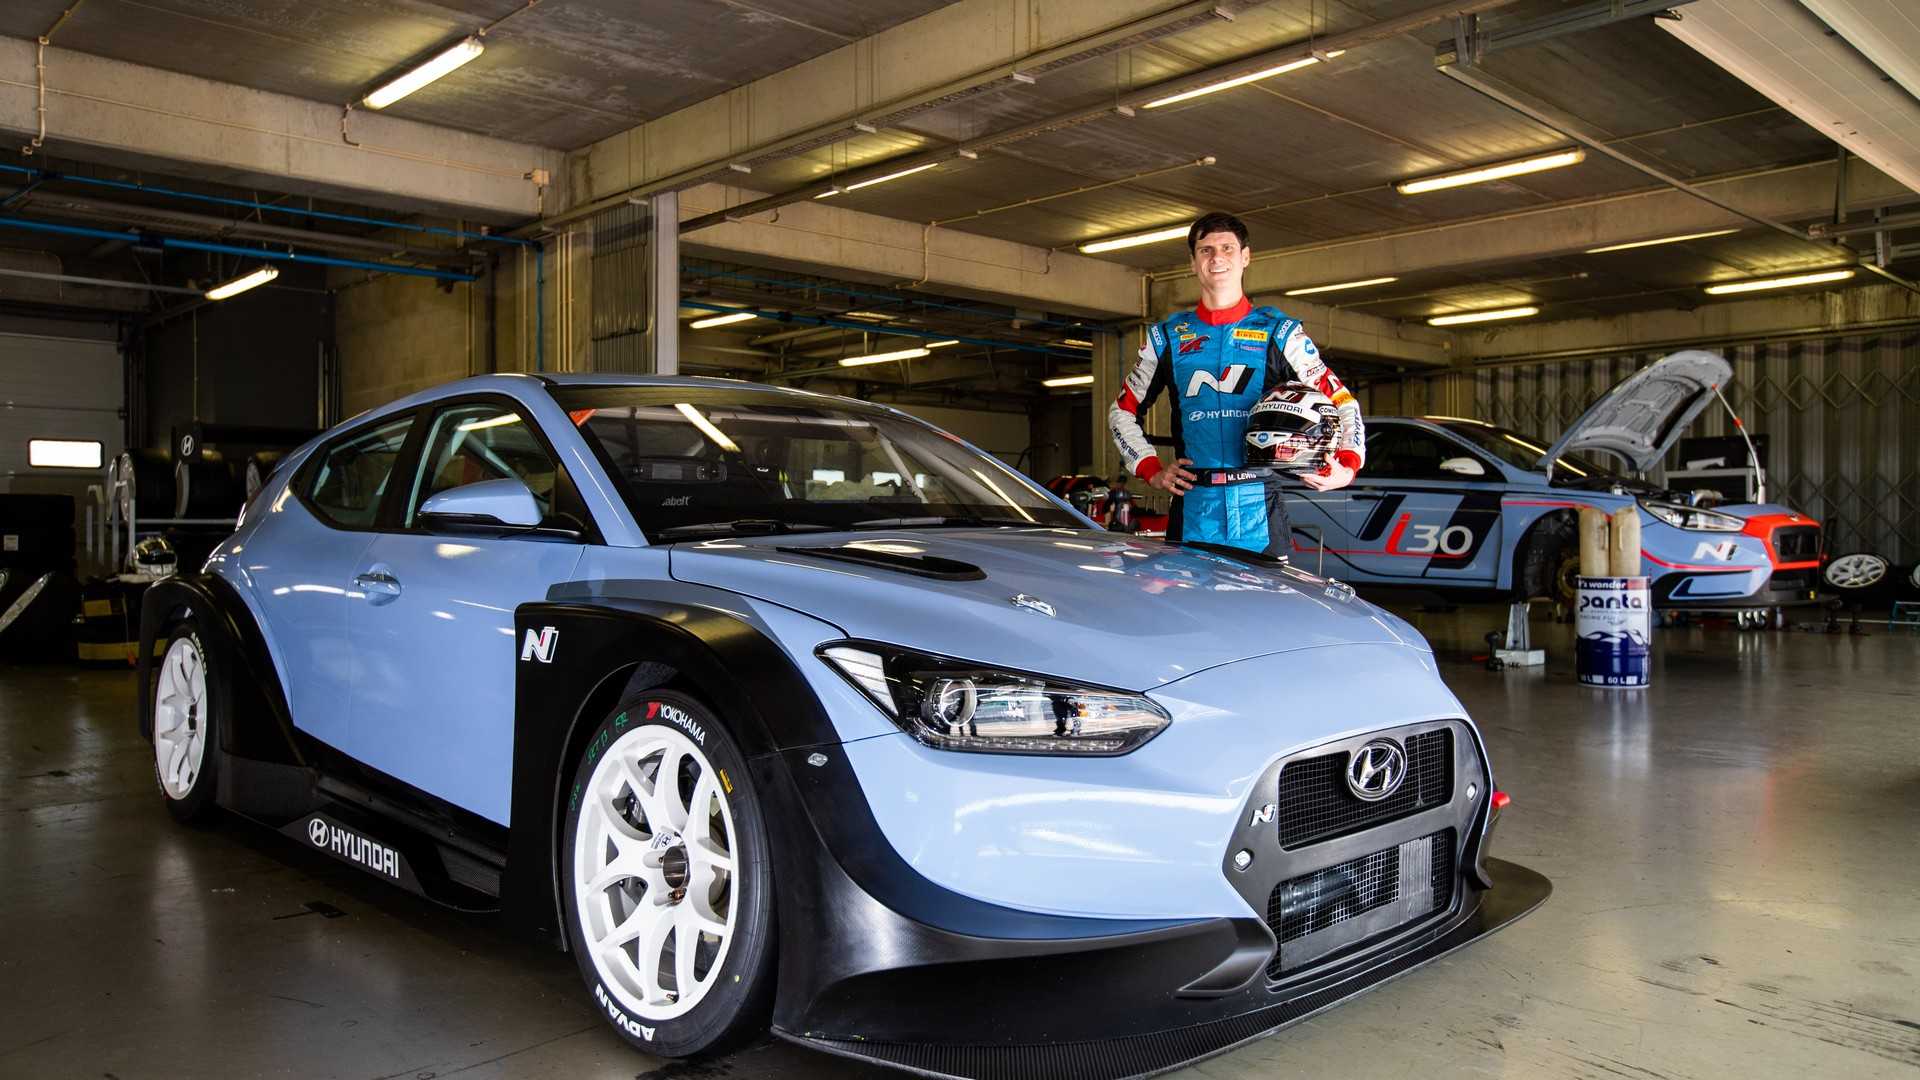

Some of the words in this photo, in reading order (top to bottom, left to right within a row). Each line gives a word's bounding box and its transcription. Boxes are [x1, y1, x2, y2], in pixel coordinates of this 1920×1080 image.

[1207, 410, 1249, 419] HYUNDA
[1261, 402, 1303, 415] HYUNDAI
[1385, 512, 1474, 556] i30
[1580, 594, 1642, 612] panta
[660, 703, 706, 746] YOKOHAMA
[331, 825, 399, 879] HYUNDAI
[595, 983, 656, 1042] ADVAN
